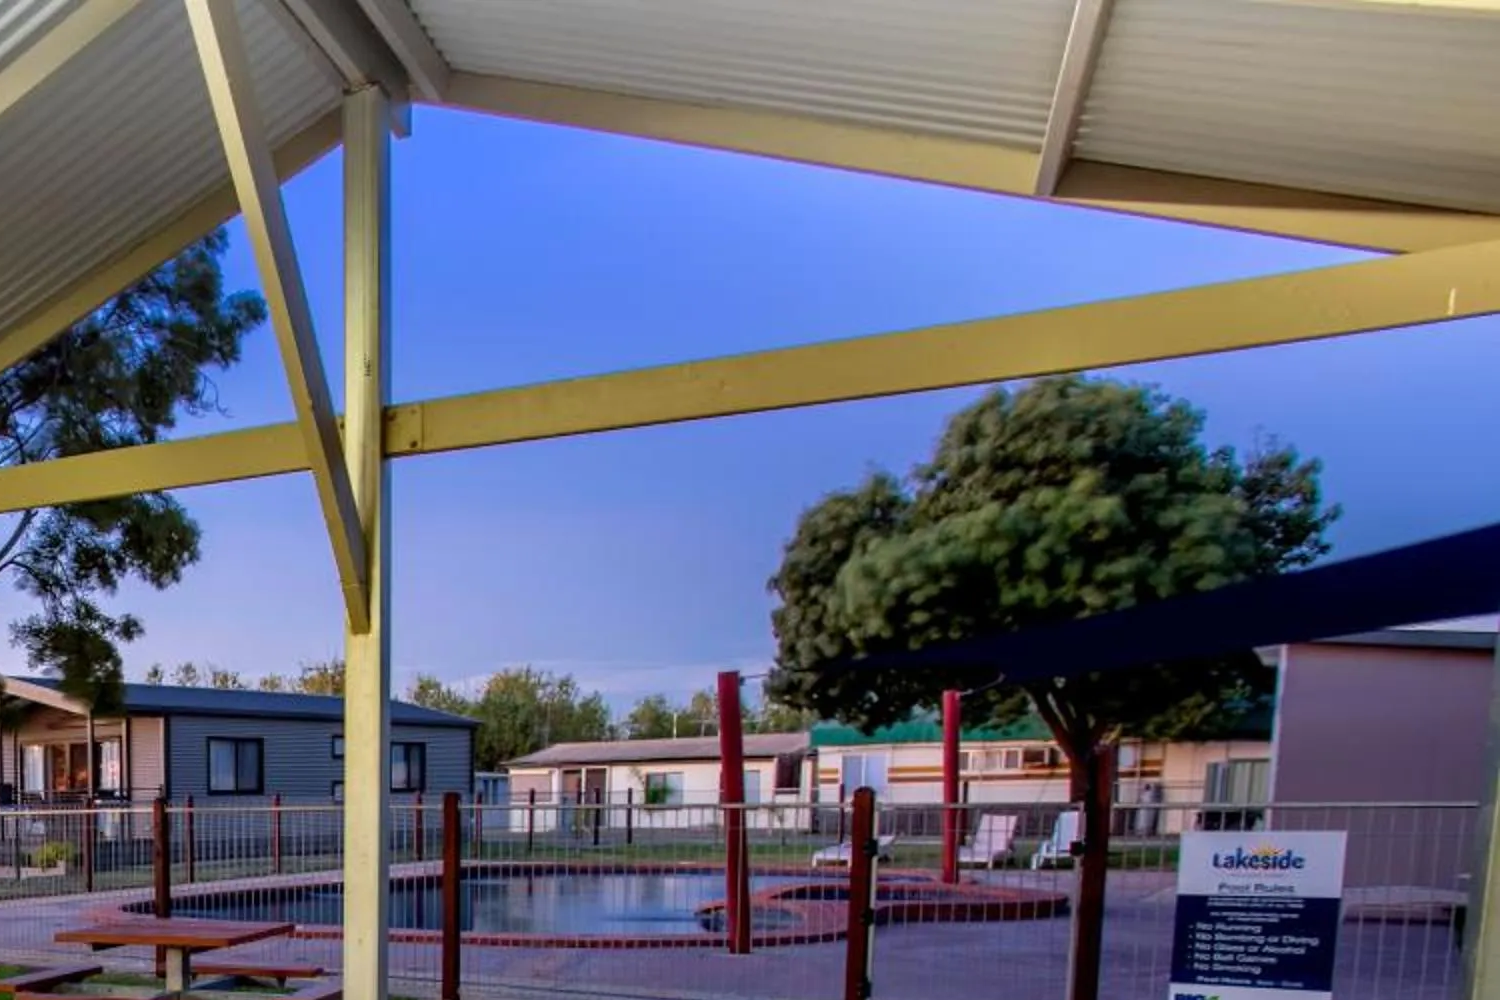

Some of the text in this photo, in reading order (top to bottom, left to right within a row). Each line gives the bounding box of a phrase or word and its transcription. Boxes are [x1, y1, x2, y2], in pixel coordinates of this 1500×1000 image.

[1213, 847, 1305, 869] Lakeside
[1196, 922, 1262, 934] No Running
[1195, 942, 1211, 951] No
[1194, 952, 1210, 961] No
[1193, 962, 1210, 971] No
